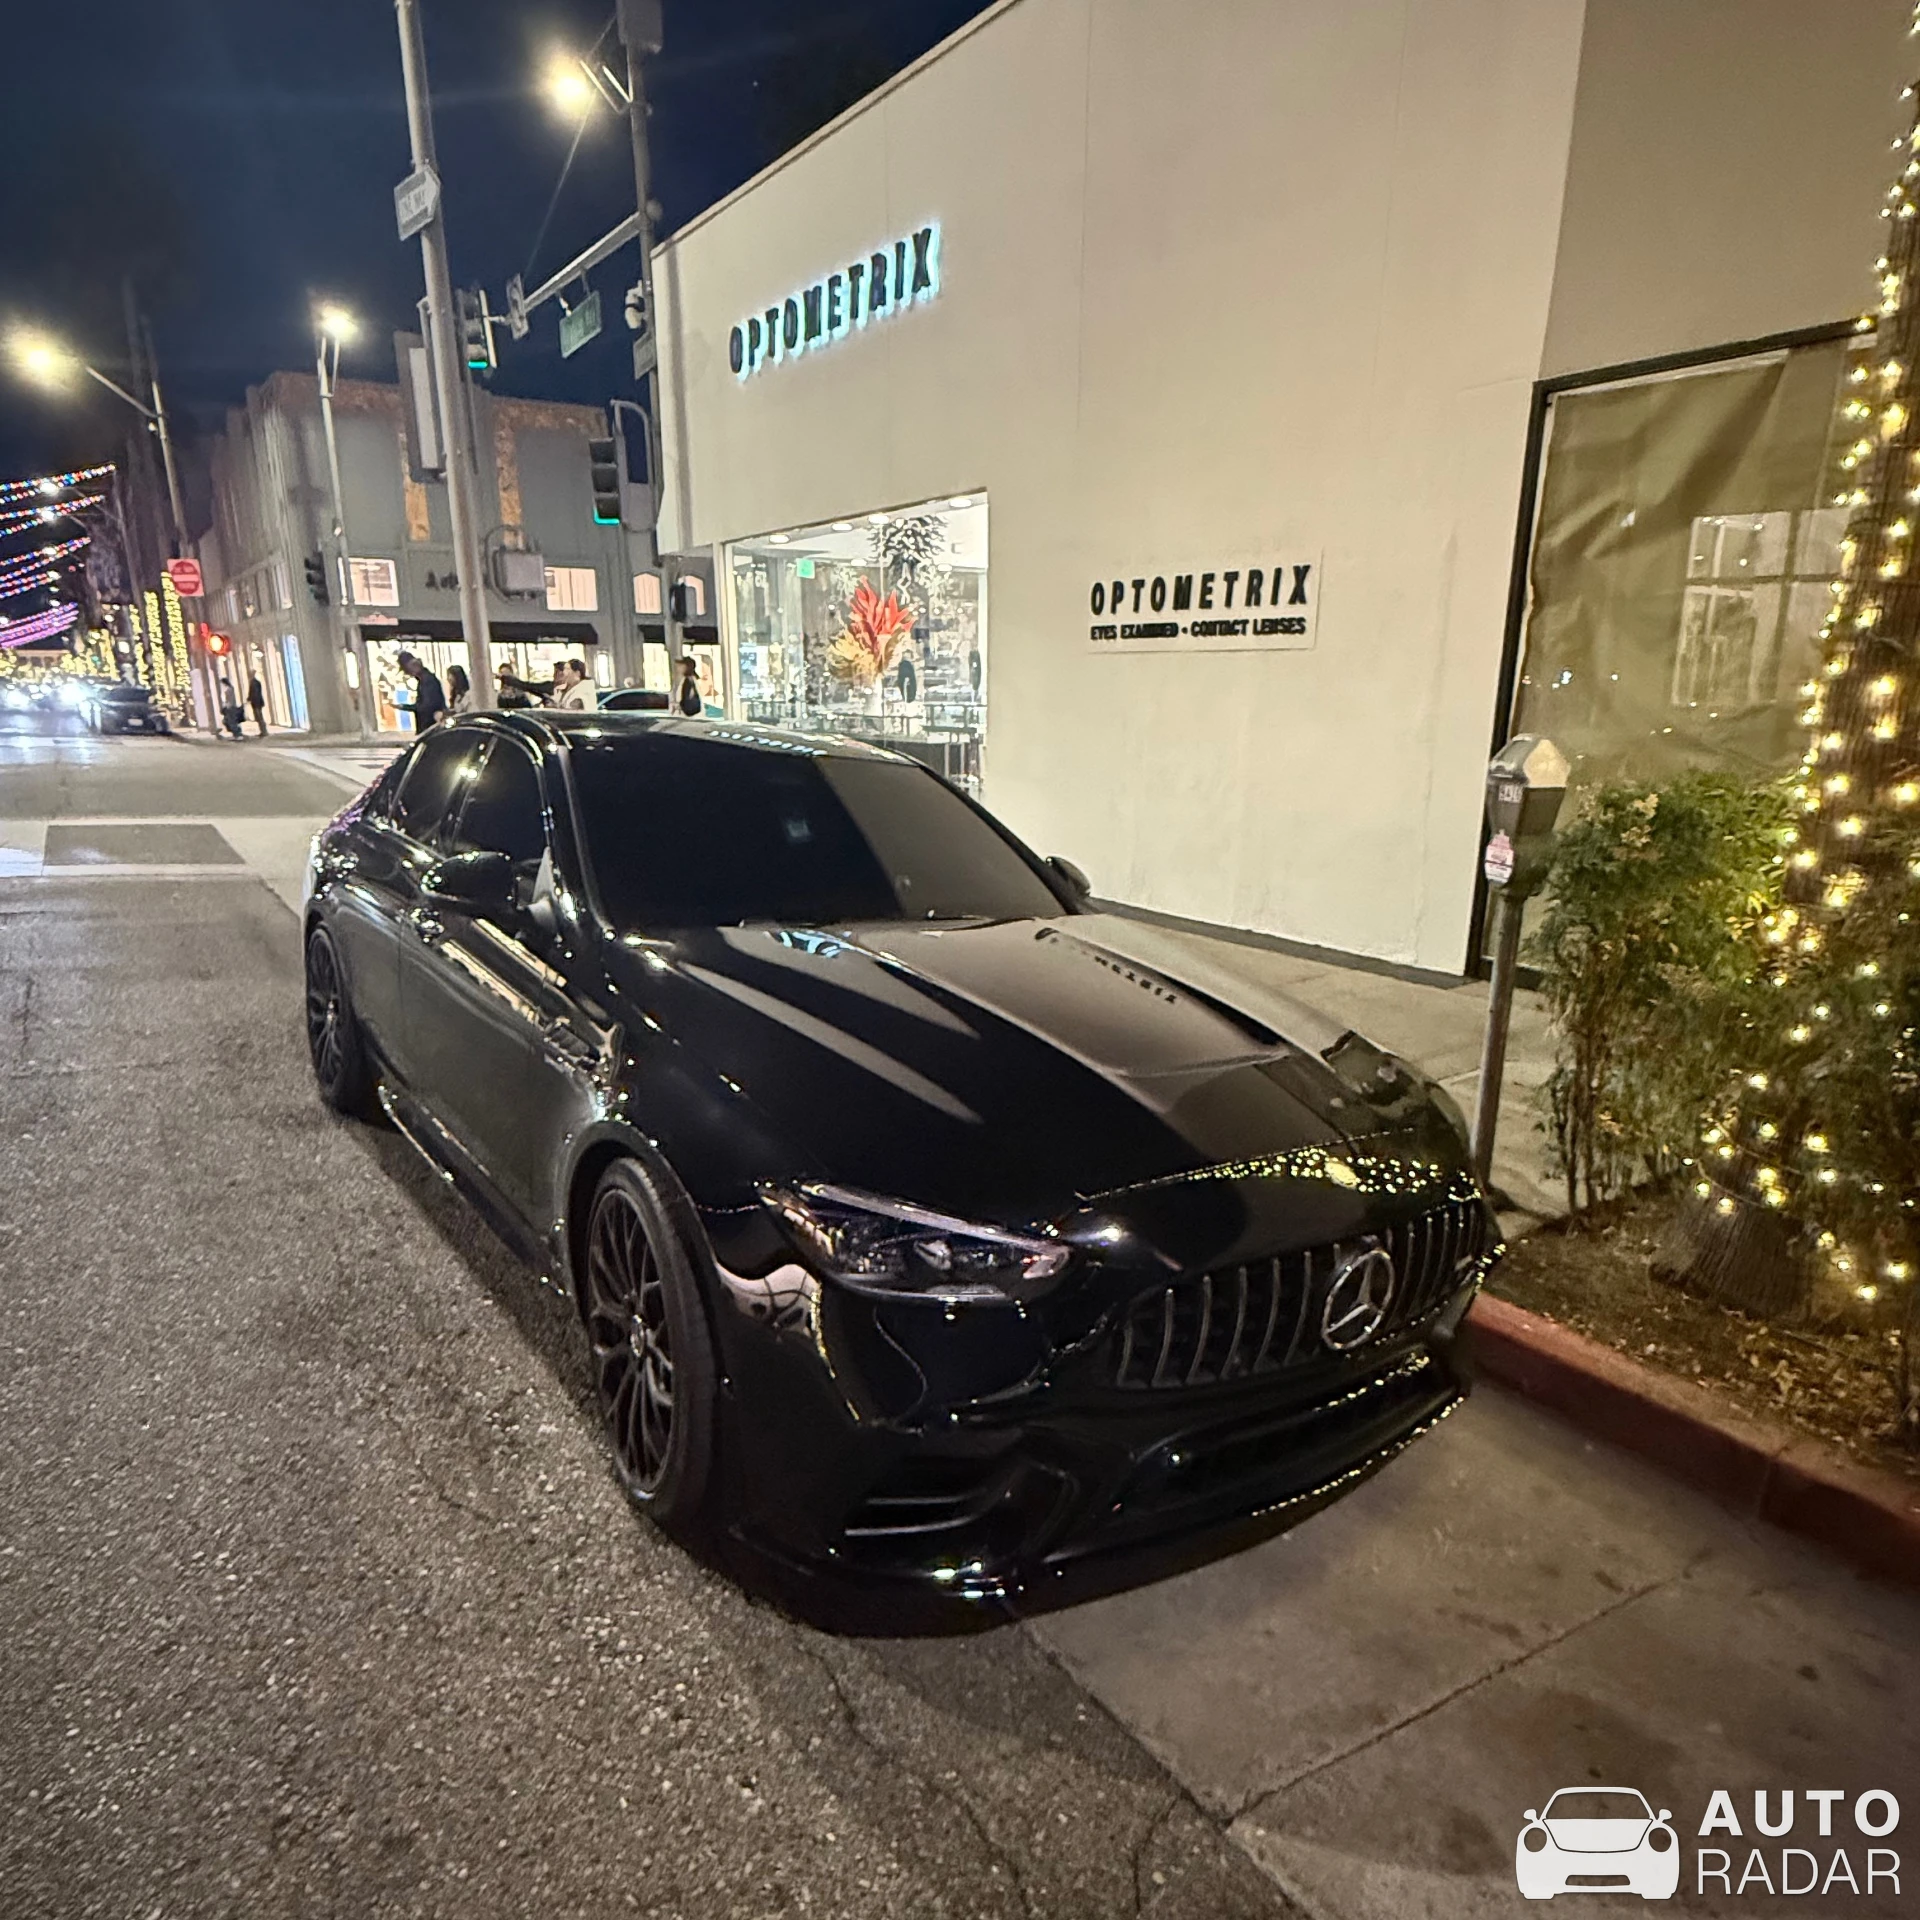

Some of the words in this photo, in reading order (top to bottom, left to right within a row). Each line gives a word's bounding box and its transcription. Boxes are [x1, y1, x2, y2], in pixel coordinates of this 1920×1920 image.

[729, 226, 935, 376] OPTOMETRIX
[1090, 564, 1311, 616] OPTOMETRIX
[1090, 624, 1118, 641] EYES
[1190, 618, 1250, 638] CONTACT
[1252, 616, 1307, 636] LENSES
